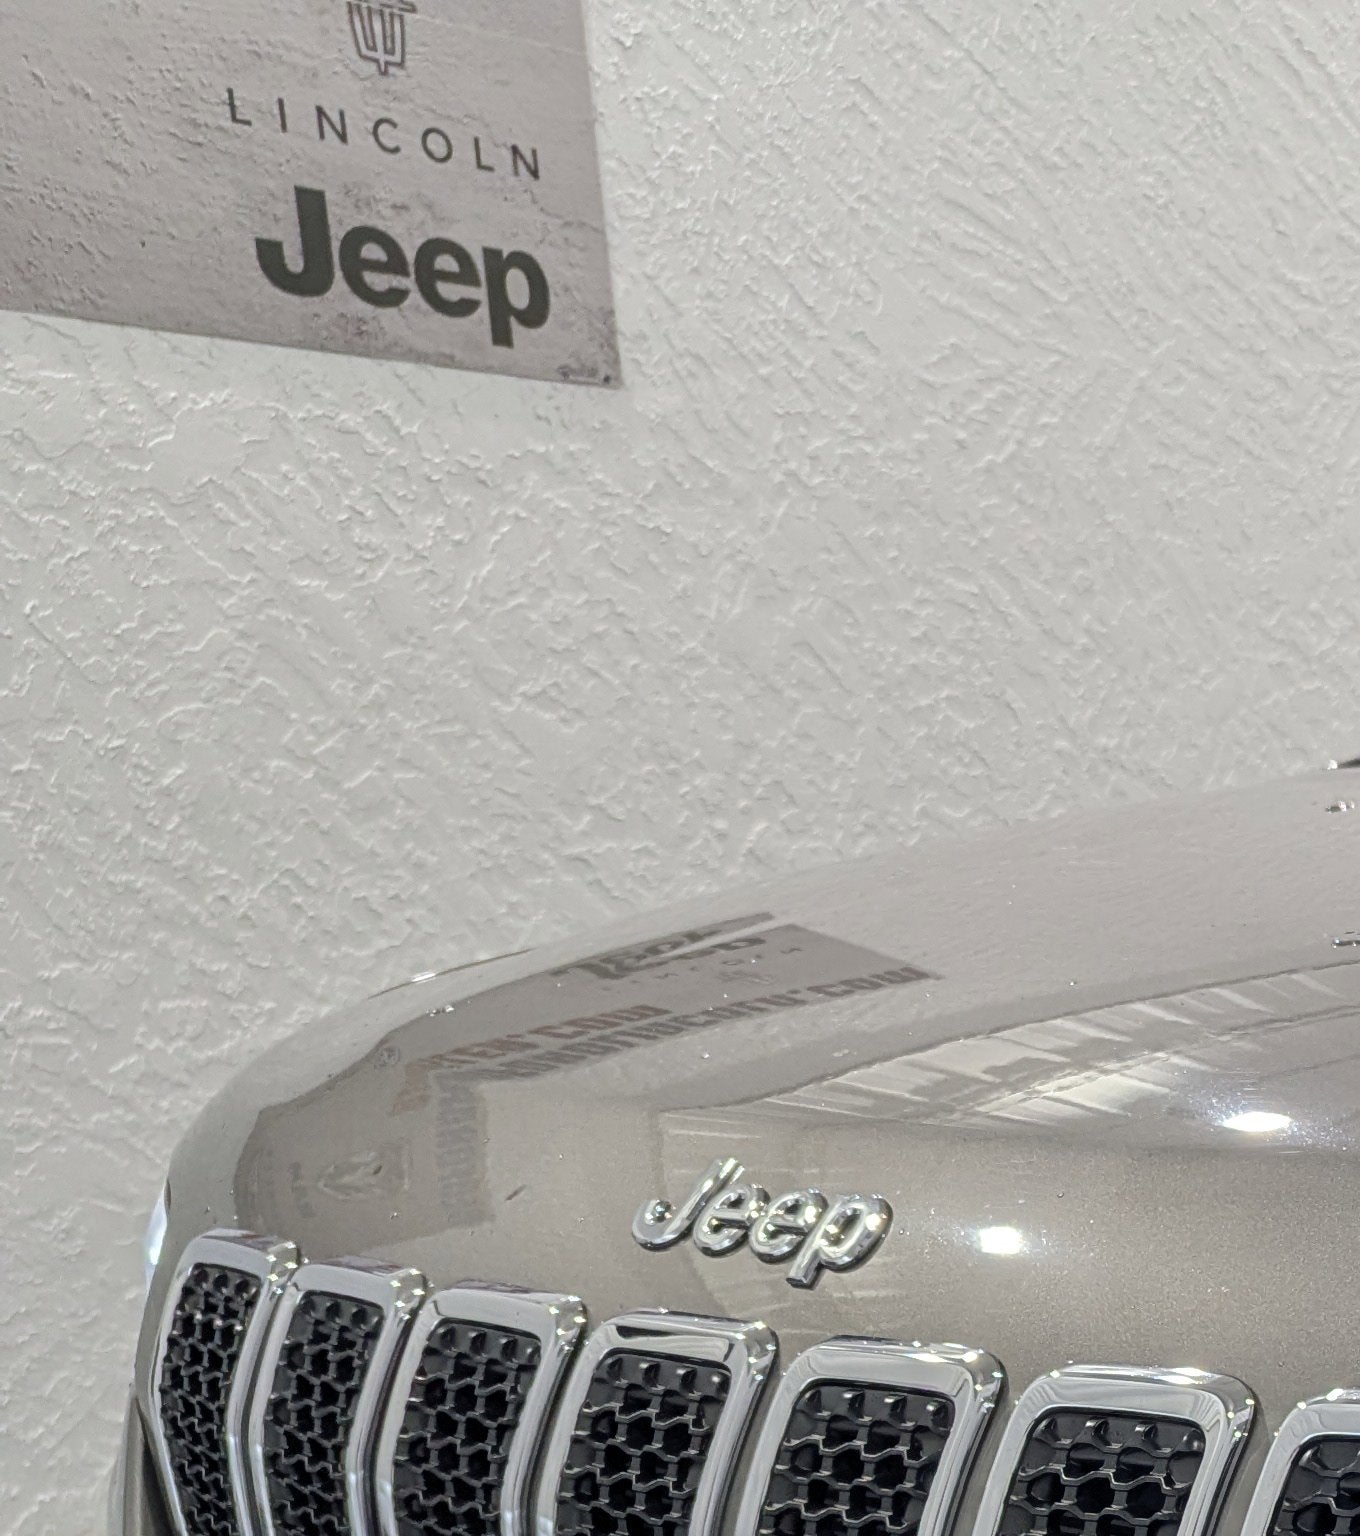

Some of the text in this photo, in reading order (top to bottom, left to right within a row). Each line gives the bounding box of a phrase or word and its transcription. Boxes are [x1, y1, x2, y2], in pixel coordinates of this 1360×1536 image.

[227, 87, 540, 180] LINCOLN
[255, 185, 550, 348] Jeep
[631, 1156, 894, 1291] Jeep
